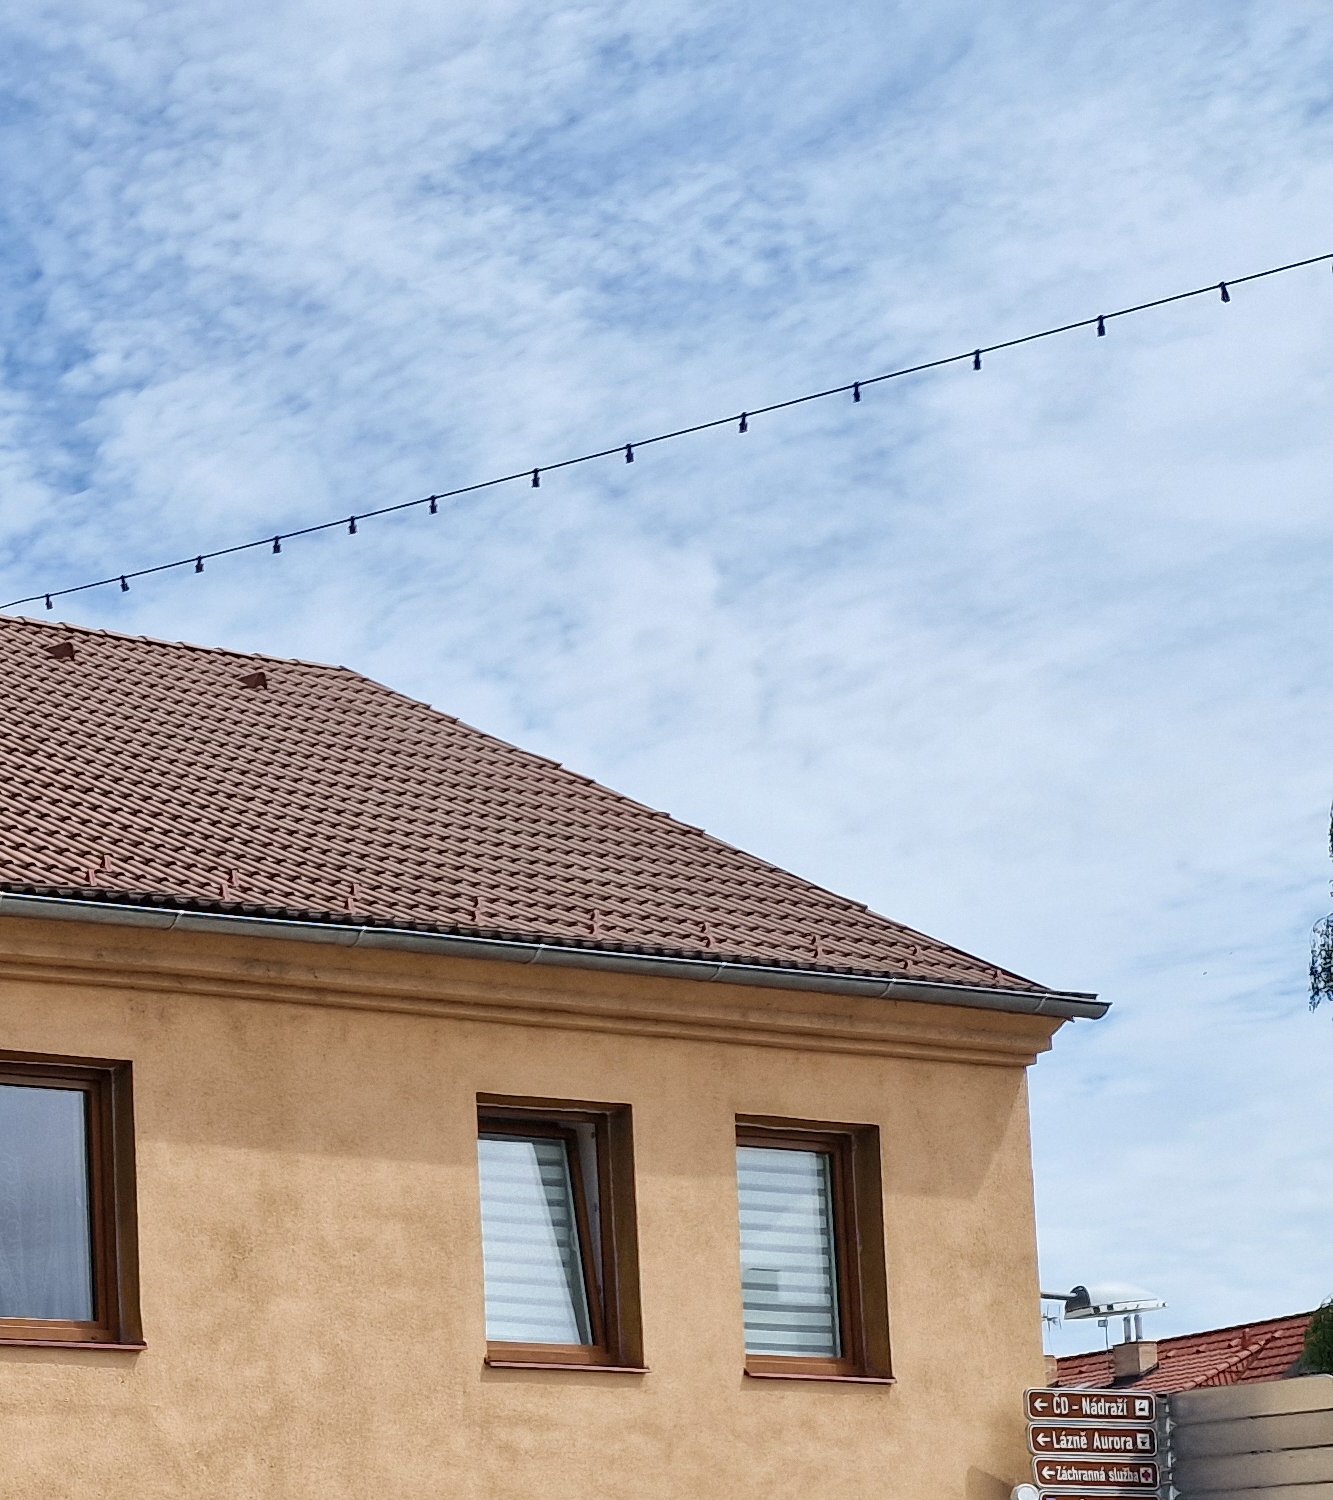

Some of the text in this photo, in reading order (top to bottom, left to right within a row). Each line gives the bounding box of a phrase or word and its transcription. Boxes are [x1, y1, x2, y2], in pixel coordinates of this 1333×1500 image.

[1053, 1392, 1069, 1415] ČD
[1082, 1397, 1128, 1416] Nádraží
[1052, 1430, 1133, 1450] Lázně Aurora
[1055, 1466, 1140, 1482] Záchranná služba
